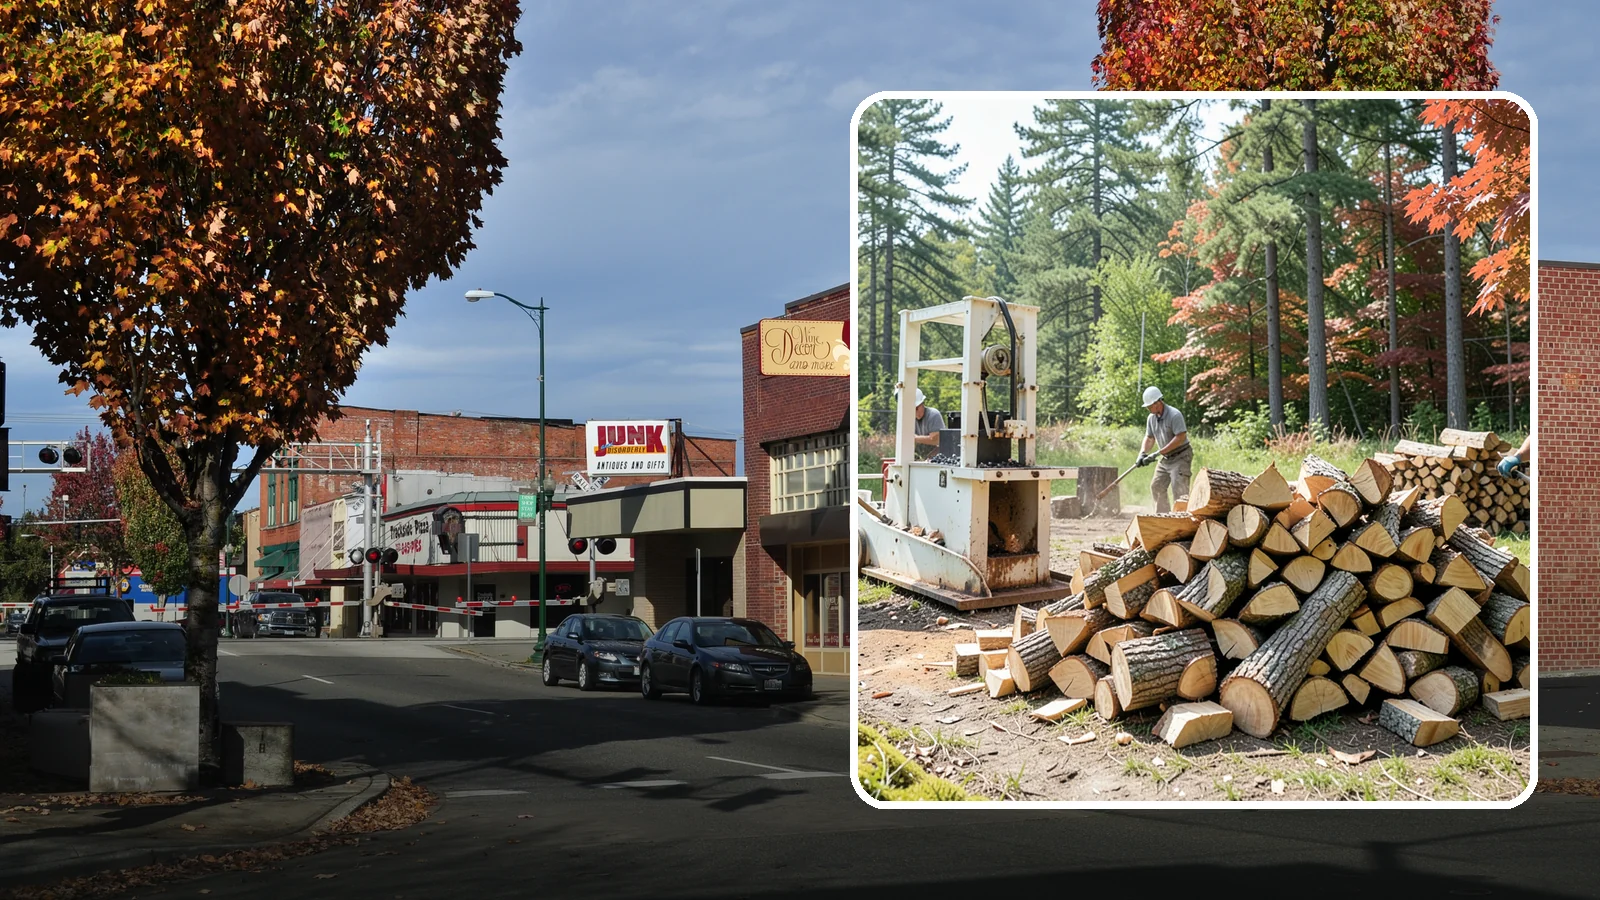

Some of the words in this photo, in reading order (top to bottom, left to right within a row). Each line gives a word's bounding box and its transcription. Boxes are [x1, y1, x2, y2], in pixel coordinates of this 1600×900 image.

[595, 425, 666, 457] JUNK
[607, 446, 646, 454] DISORDERLY
[597, 461, 628, 470] ANTIQUES
[631, 461, 644, 470] AND
[647, 460, 665, 470] GIFTS
[414, 519, 429, 534] Pizza
